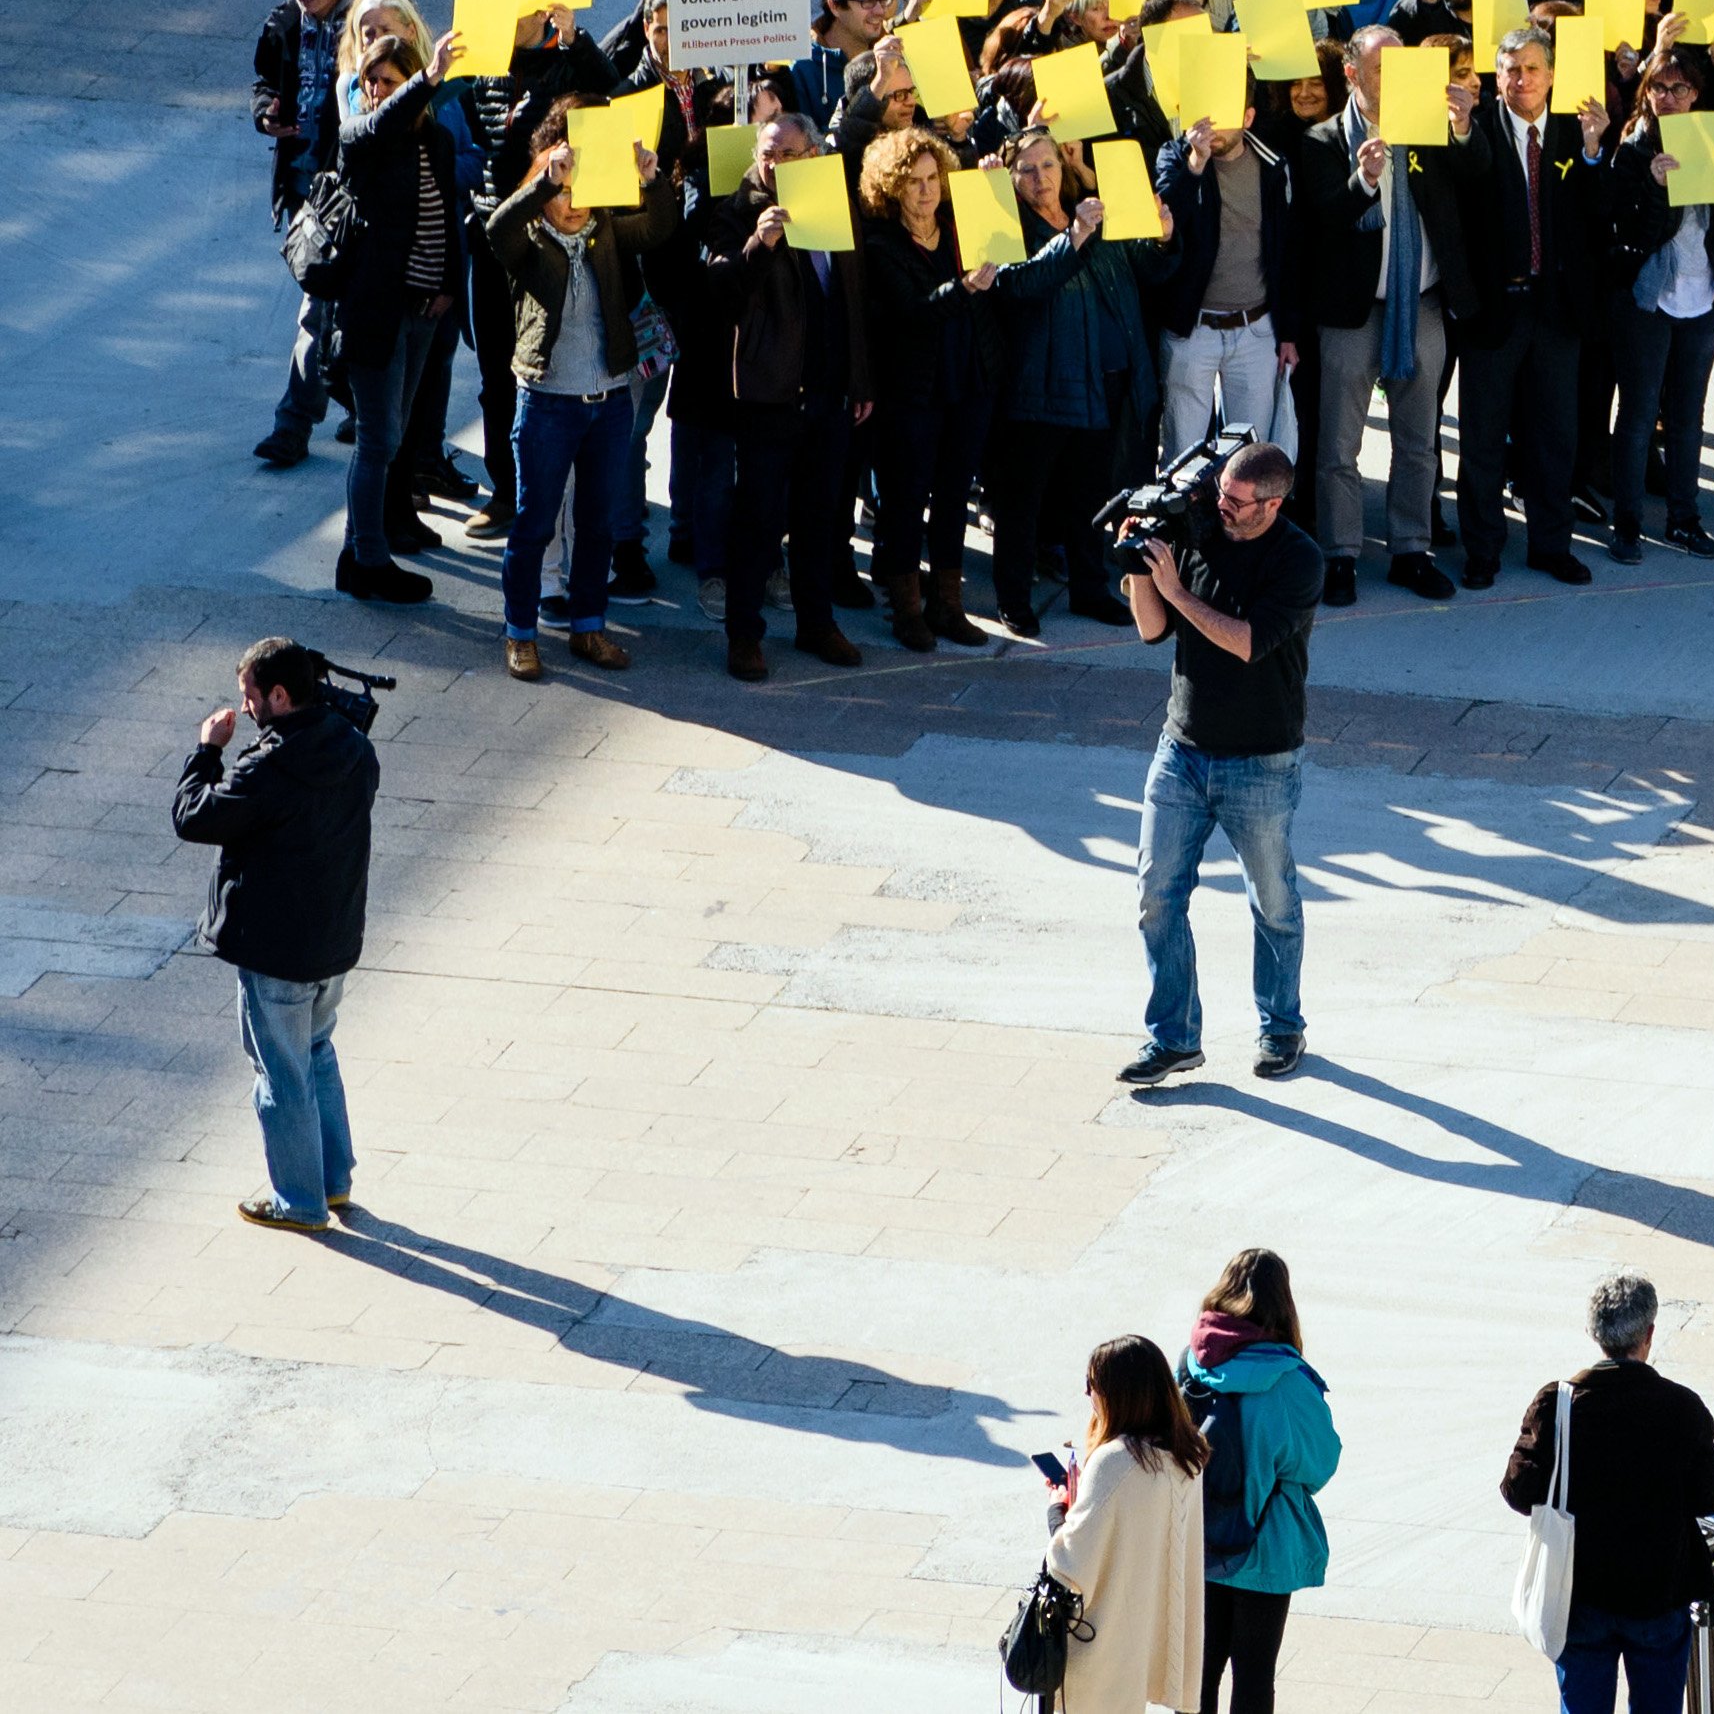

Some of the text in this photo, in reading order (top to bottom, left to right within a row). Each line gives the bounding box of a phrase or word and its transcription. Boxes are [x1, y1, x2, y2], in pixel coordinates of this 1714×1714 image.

[681, 10, 788, 32] govern legítim
[682, 38, 728, 49] #Llibertat
[730, 37, 761, 47] Presos
